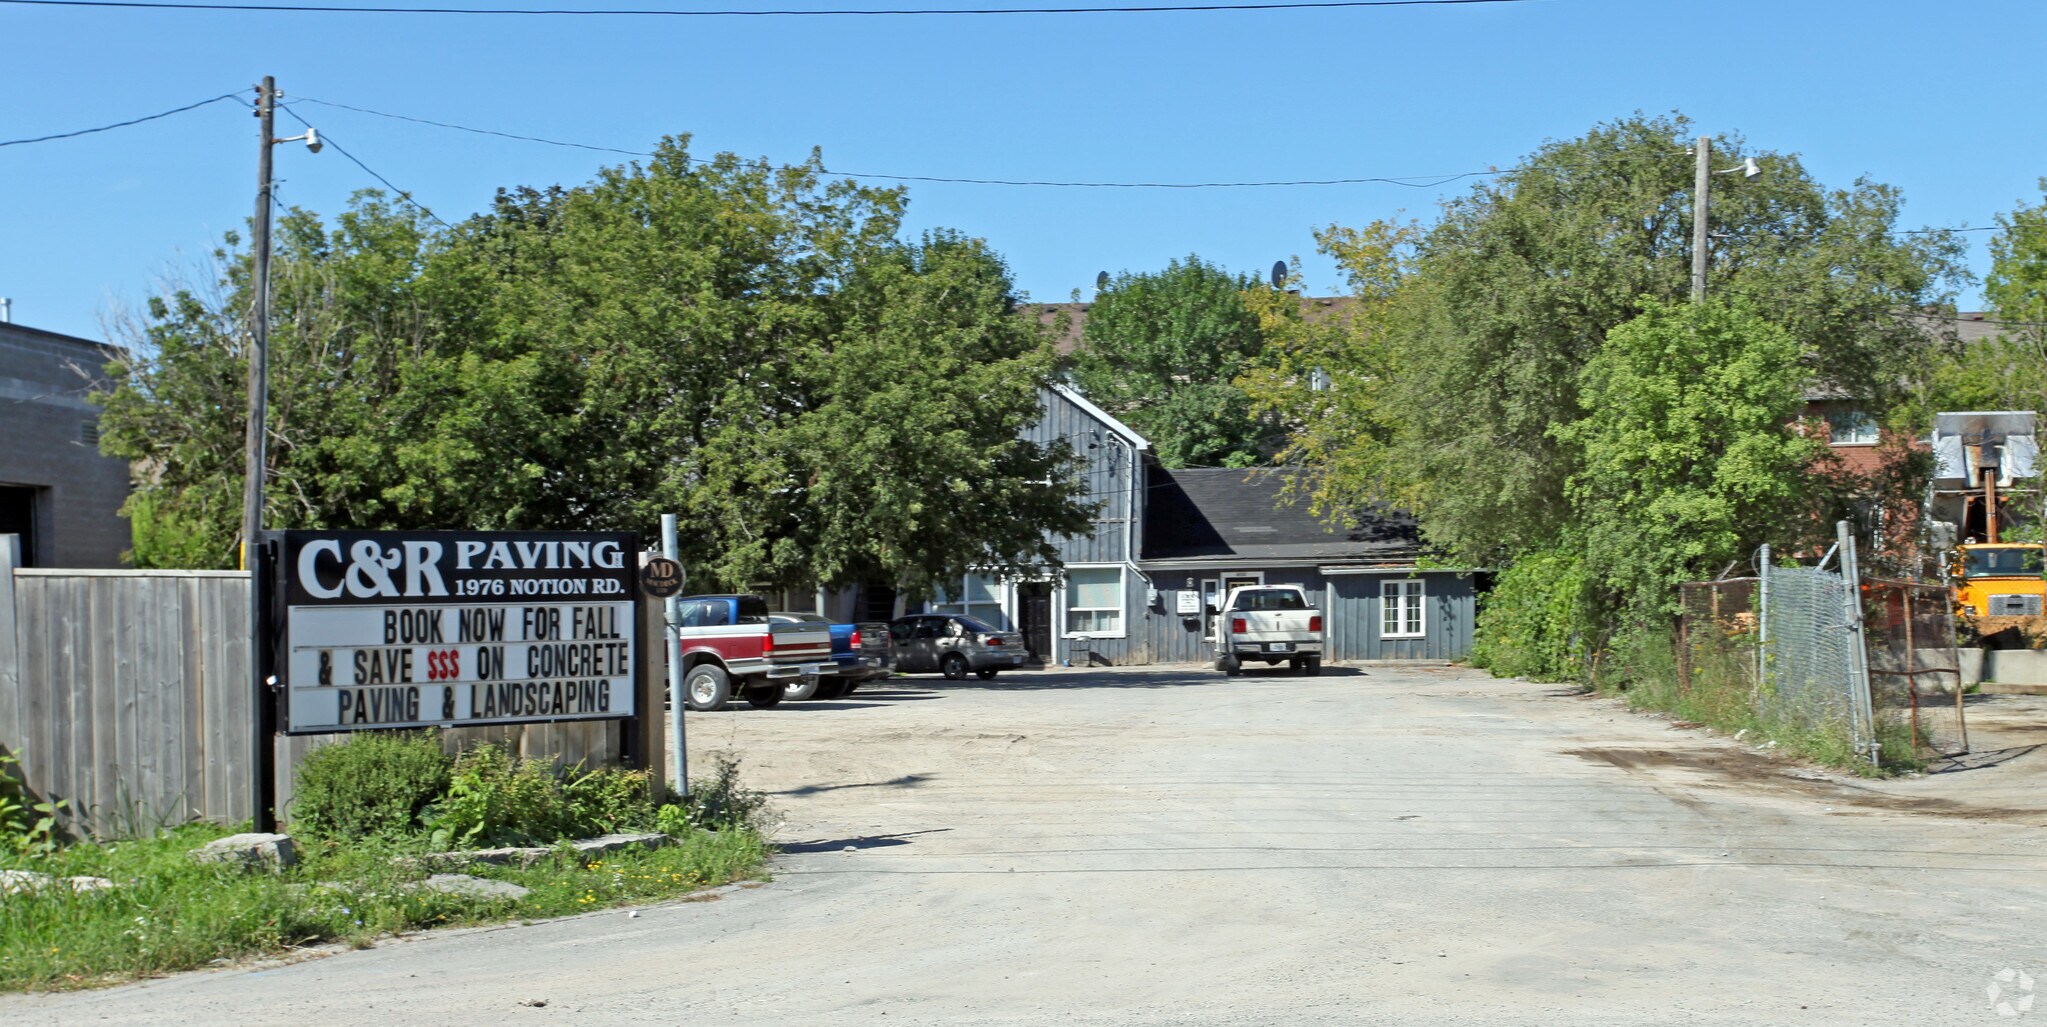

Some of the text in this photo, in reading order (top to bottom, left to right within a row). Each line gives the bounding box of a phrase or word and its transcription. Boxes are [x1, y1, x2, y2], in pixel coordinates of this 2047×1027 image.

[297, 539, 625, 598] C&R PAVING
[455, 578, 625, 596] 1976 NOTION RD.
[650, 562, 674, 578] MD
[384, 606, 620, 645] BOOK NOW FOR FALL
[319, 651, 333, 686] &
[354, 648, 413, 685] SAVE
[477, 645, 504, 681] ON
[527, 642, 628, 679] CONCRETE
[338, 679, 610, 726] PAVING & LANDSCAPING
